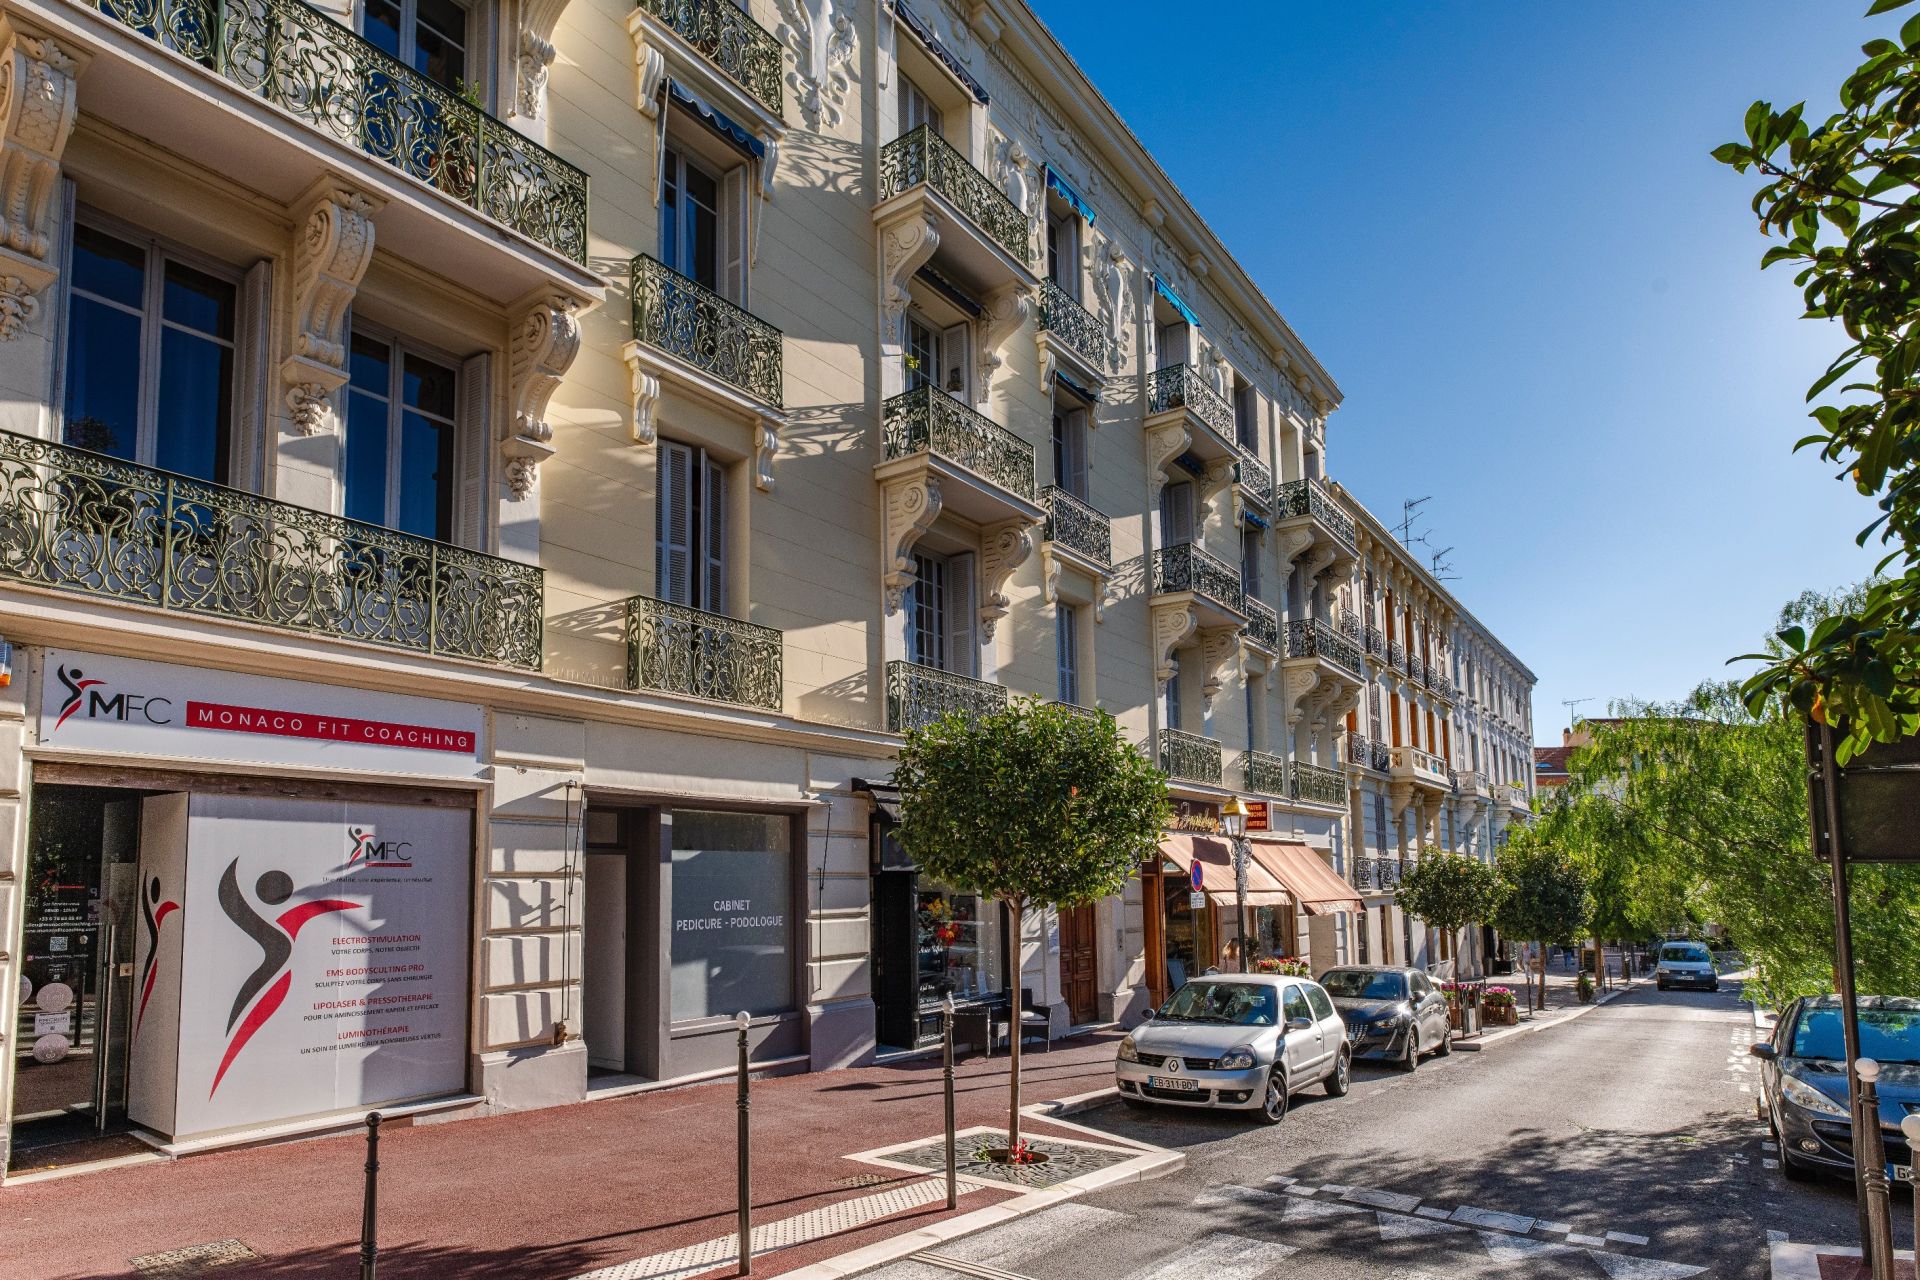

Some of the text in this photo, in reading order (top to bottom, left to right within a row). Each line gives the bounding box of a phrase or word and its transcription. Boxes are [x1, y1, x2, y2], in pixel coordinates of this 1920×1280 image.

[89, 690, 172, 724] MFC
[199, 709, 467, 747] MONACO FIT COACHING
[365, 841, 412, 861] MFC
[713, 899, 751, 911] CABINET
[676, 918, 722, 931] PEDICURE
[730, 915, 783, 928] PODOLOGUE
[332, 934, 421, 945] ELECTROSTIMULATION
[326, 968, 344, 977] EMS
[408, 964, 424, 972] PRO
[315, 980, 344, 988] SCULPTEZ
[313, 999, 357, 1011] LIPOLASER
[359, 998, 366, 1006] &
[335, 1008, 384, 1018] AMINCISSEMENT
[414, 1003, 440, 1011] EFFICACE
[338, 1025, 409, 1040] LUMINOTHÉRAPIE
[312, 1045, 328, 1053] SOIN
[380, 1035, 420, 1044] NOMBREUSES
[420, 1032, 441, 1040] VERTUS
